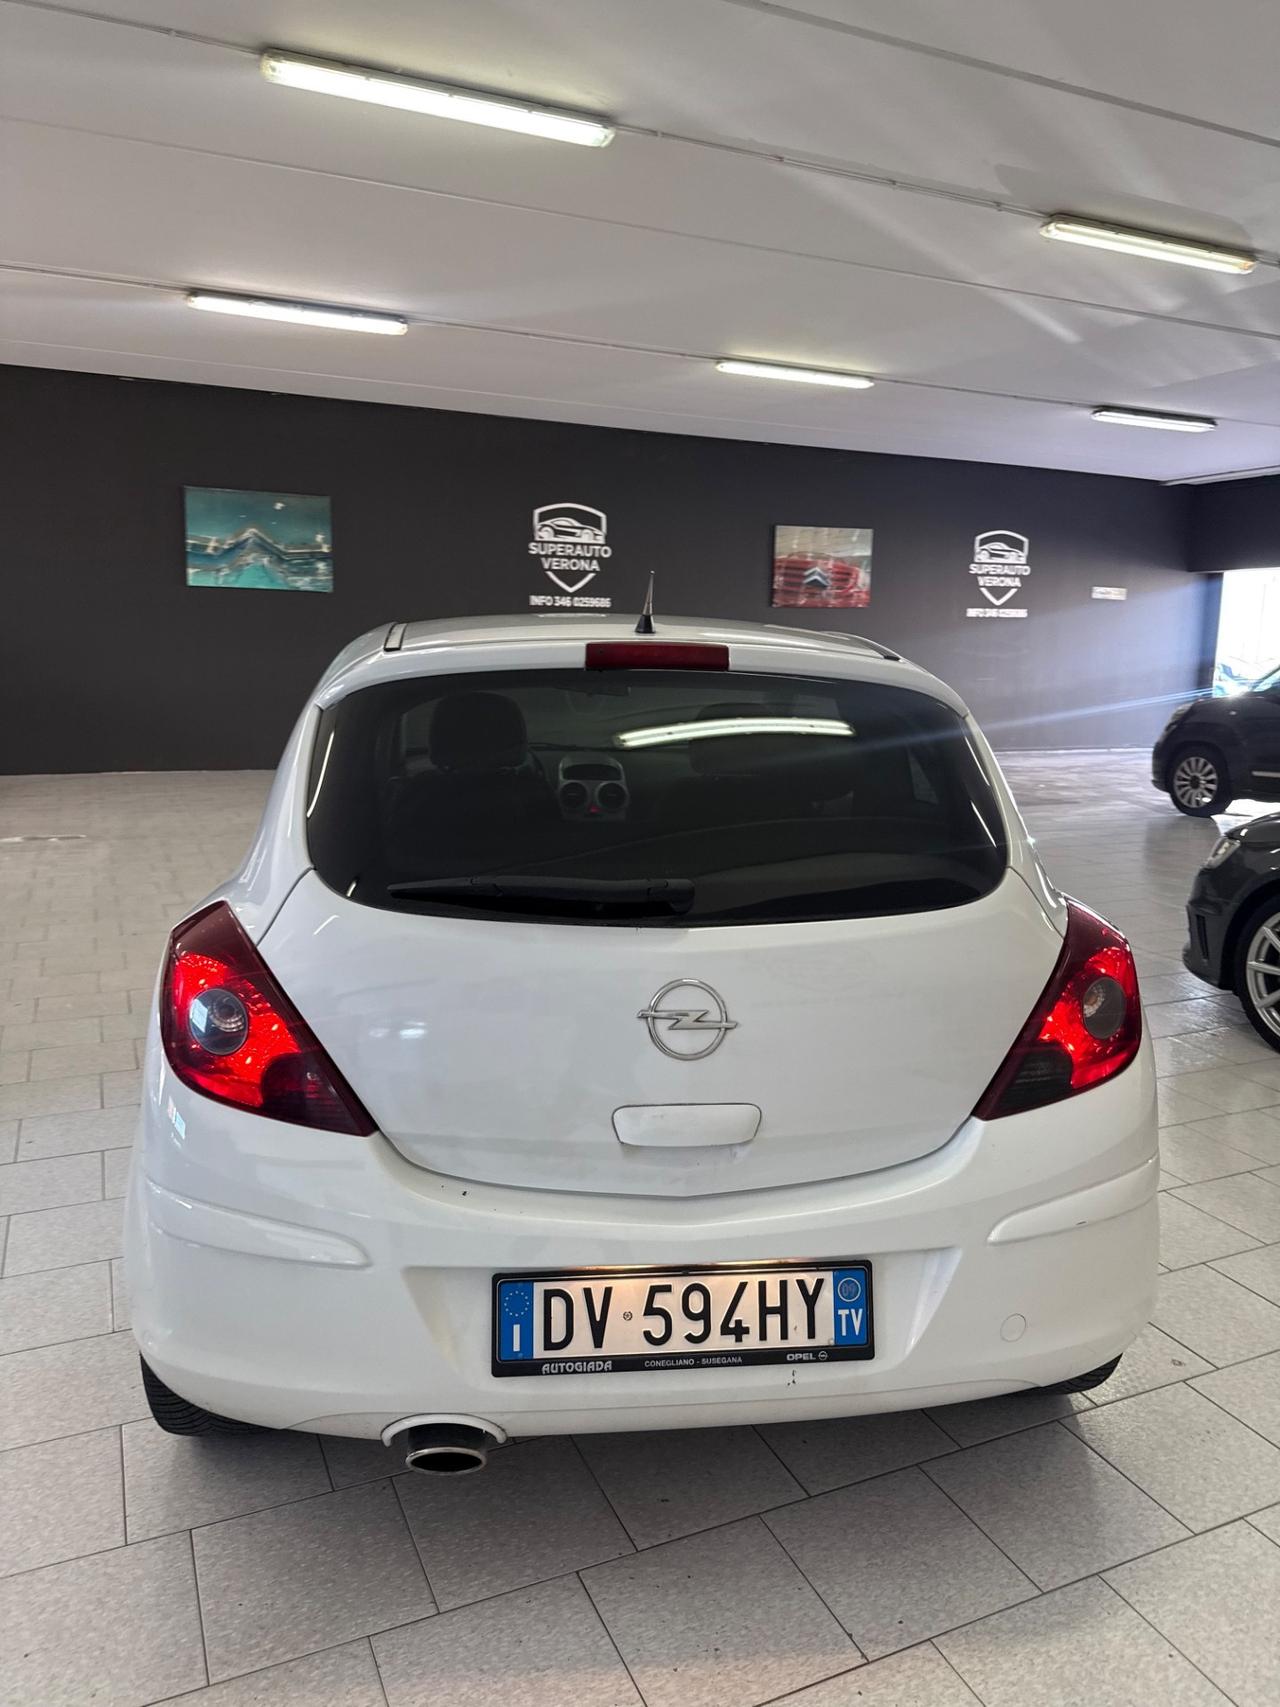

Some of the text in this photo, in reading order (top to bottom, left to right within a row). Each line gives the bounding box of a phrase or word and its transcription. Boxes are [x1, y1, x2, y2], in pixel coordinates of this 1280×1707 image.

[528, 542, 612, 558] SUPERAUTO
[541, 557, 600, 571] VERONA
[969, 564, 1031, 575] SUPERAUTO
[977, 576, 1022, 587] VERONA
[529, 595, 553, 606] INFO
[543, 1277, 825, 1352] DV 594HY
[838, 1308, 863, 1336] TV
[644, 1357, 695, 1368] CONEGLIANO
[701, 1356, 743, 1365] SUSEGANA
[786, 1353, 816, 1361] OPEL
[541, 1360, 613, 1375] AUTOGIADA
